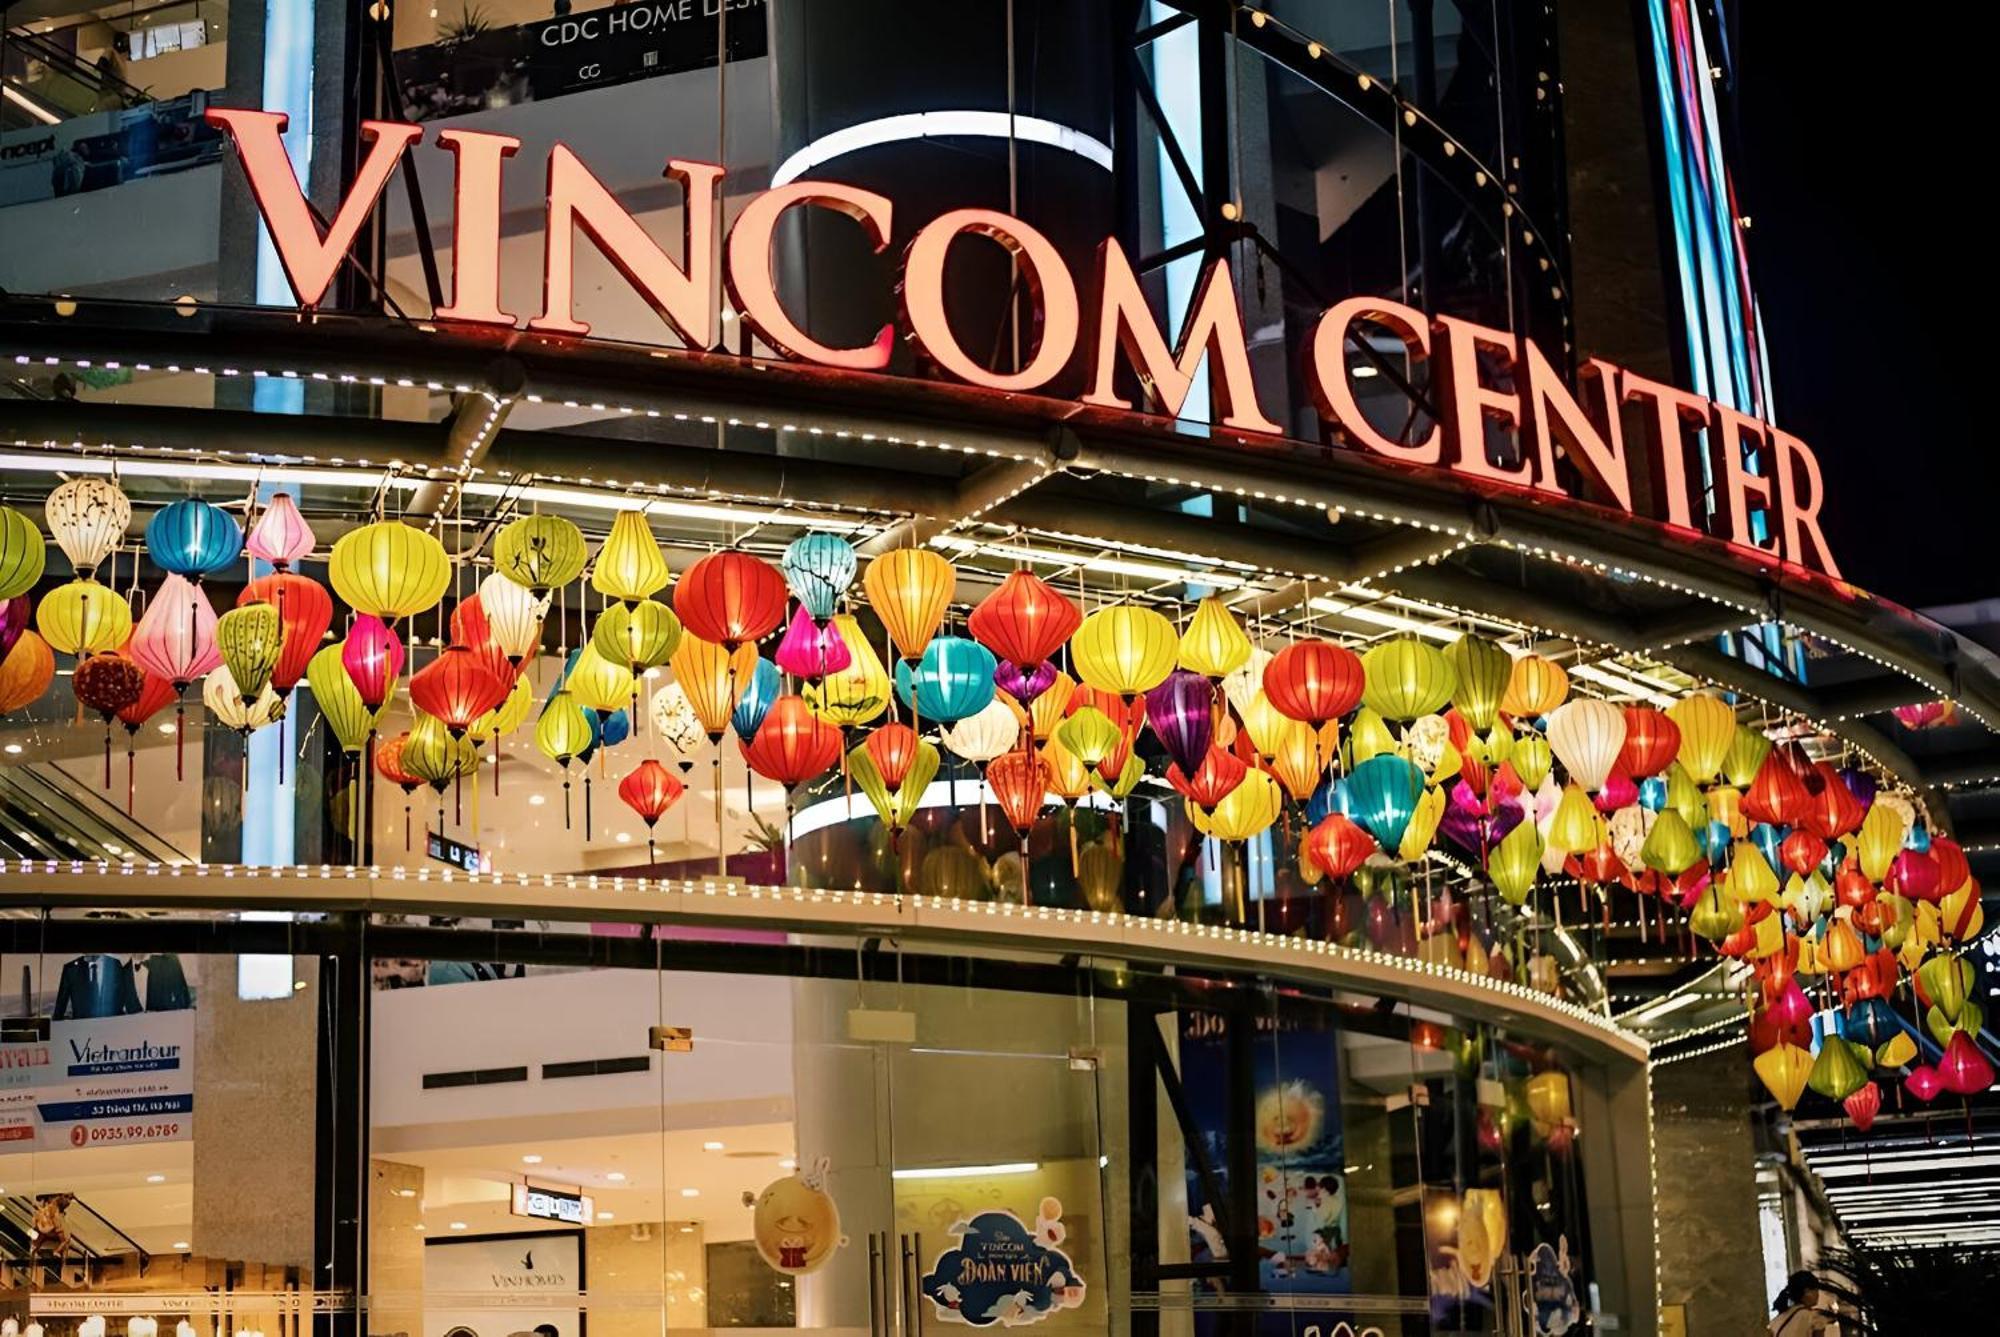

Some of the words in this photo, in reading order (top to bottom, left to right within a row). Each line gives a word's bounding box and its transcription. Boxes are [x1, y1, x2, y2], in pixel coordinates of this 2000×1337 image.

[541, 17, 599, 46] CDC
[608, 0, 692, 34] HOME
[205, 107, 1283, 436] VINCOM
[1312, 296, 1842, 580] CENTER
